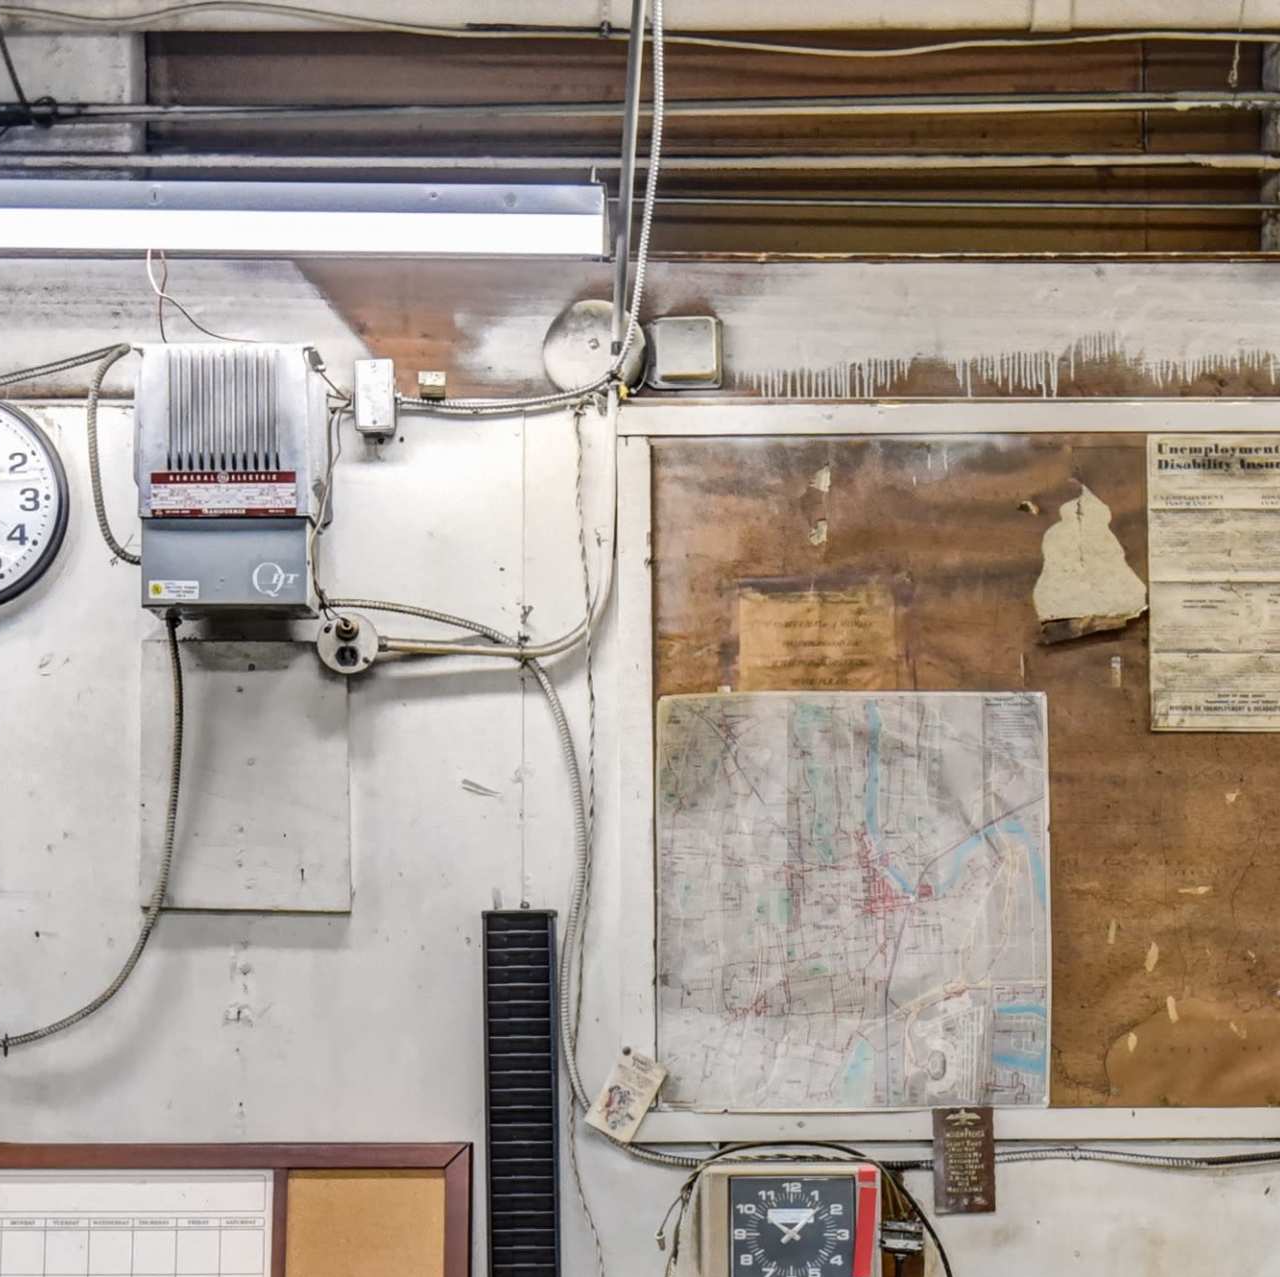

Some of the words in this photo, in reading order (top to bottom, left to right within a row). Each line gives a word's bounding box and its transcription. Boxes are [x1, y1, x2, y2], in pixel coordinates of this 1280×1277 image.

[1157, 443, 1280, 457] Unemployment
[8, 452, 28, 474] 2
[1157, 459, 1232, 472] Disability
[169, 474, 216, 482] GENERAL
[231, 474, 277, 482] ELECTRIC
[19, 488, 40, 512] 3
[6, 523, 29, 546] 4
[782, 1182, 802, 1193] 12
[758, 1190, 776, 1200] 11
[810, 1190, 819, 1201] 1
[736, 1203, 756, 1214] 10
[830, 1203, 843, 1215] 2
[734, 1228, 747, 1240] 9
[836, 1229, 850, 1240] 3
[740, 1254, 753, 1265] 8
[829, 1254, 843, 1266] 4
